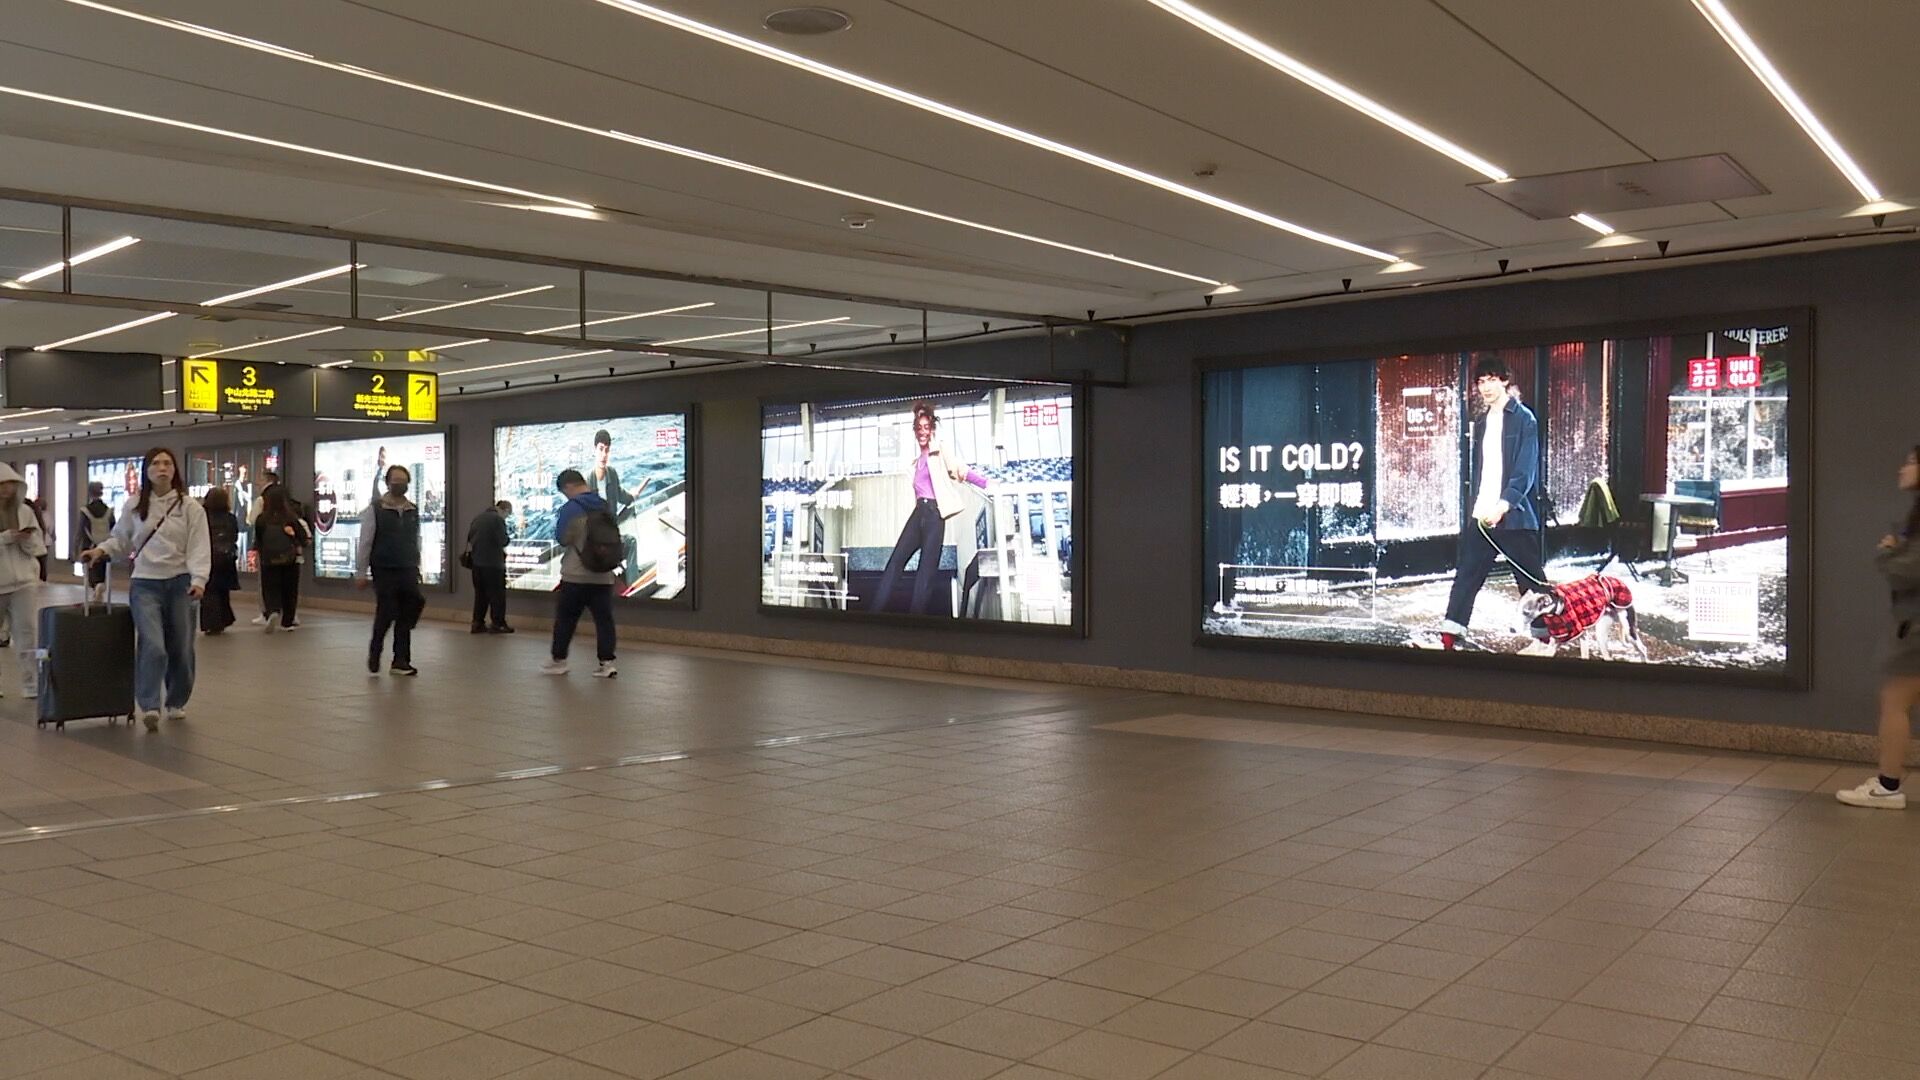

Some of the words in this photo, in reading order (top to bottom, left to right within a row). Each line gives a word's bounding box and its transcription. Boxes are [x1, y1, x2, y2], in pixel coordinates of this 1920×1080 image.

[241, 366, 256, 386] 3
[371, 374, 386, 393] 2
[1219, 446, 1241, 473] IS
[1250, 445, 1273, 472] IT
[1282, 442, 1364, 472] COLD?
